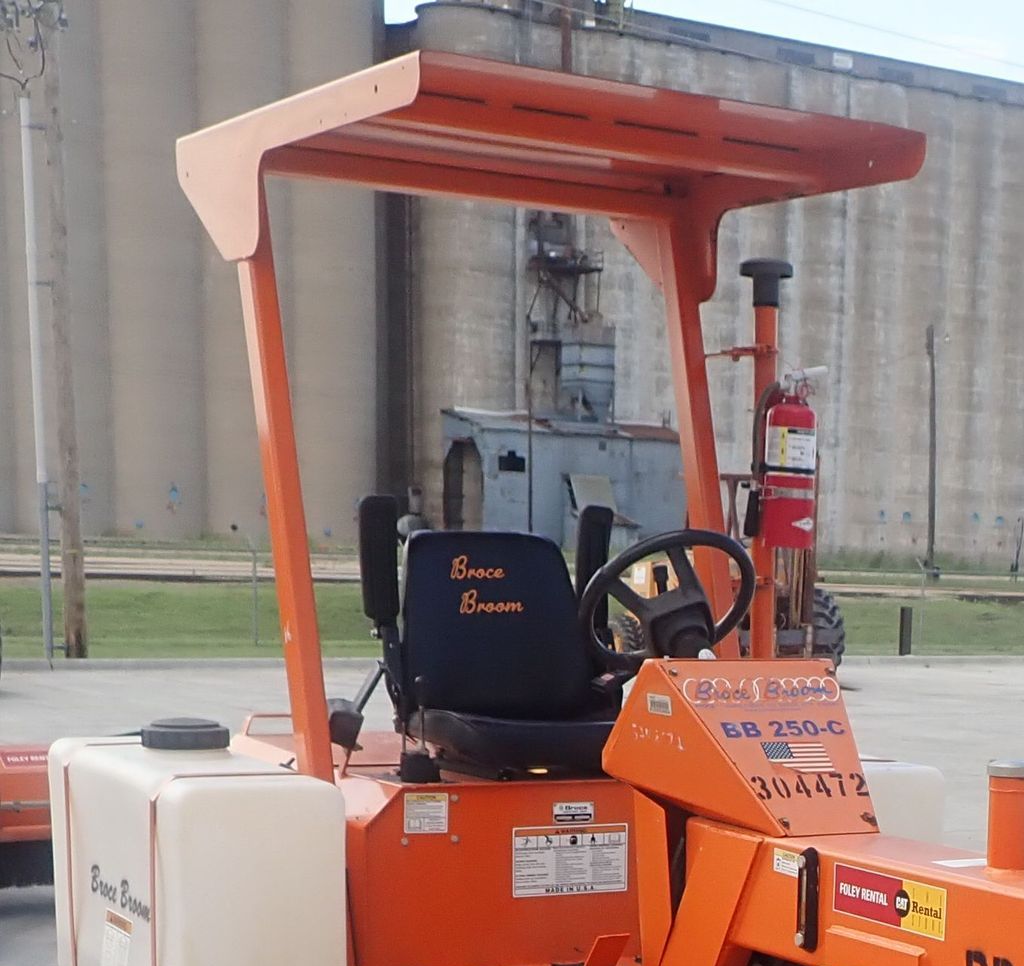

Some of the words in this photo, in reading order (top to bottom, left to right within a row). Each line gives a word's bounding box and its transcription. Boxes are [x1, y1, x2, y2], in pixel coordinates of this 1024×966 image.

[450, 555, 505, 579] Broce
[460, 589, 524, 613] Broom
[695, 680, 750, 700] Broce
[721, 722, 762, 738] BB
[768, 720, 845, 737] 250-C
[750, 772, 869, 800] 304472
[91, 864, 117, 903] Broce
[120, 879, 151, 922] Broom
[839, 882, 861, 899] FOLEY
[861, 888, 888, 906] RENTAL
[896, 897, 908, 911] CAT
[911, 901, 942, 919] Rental
